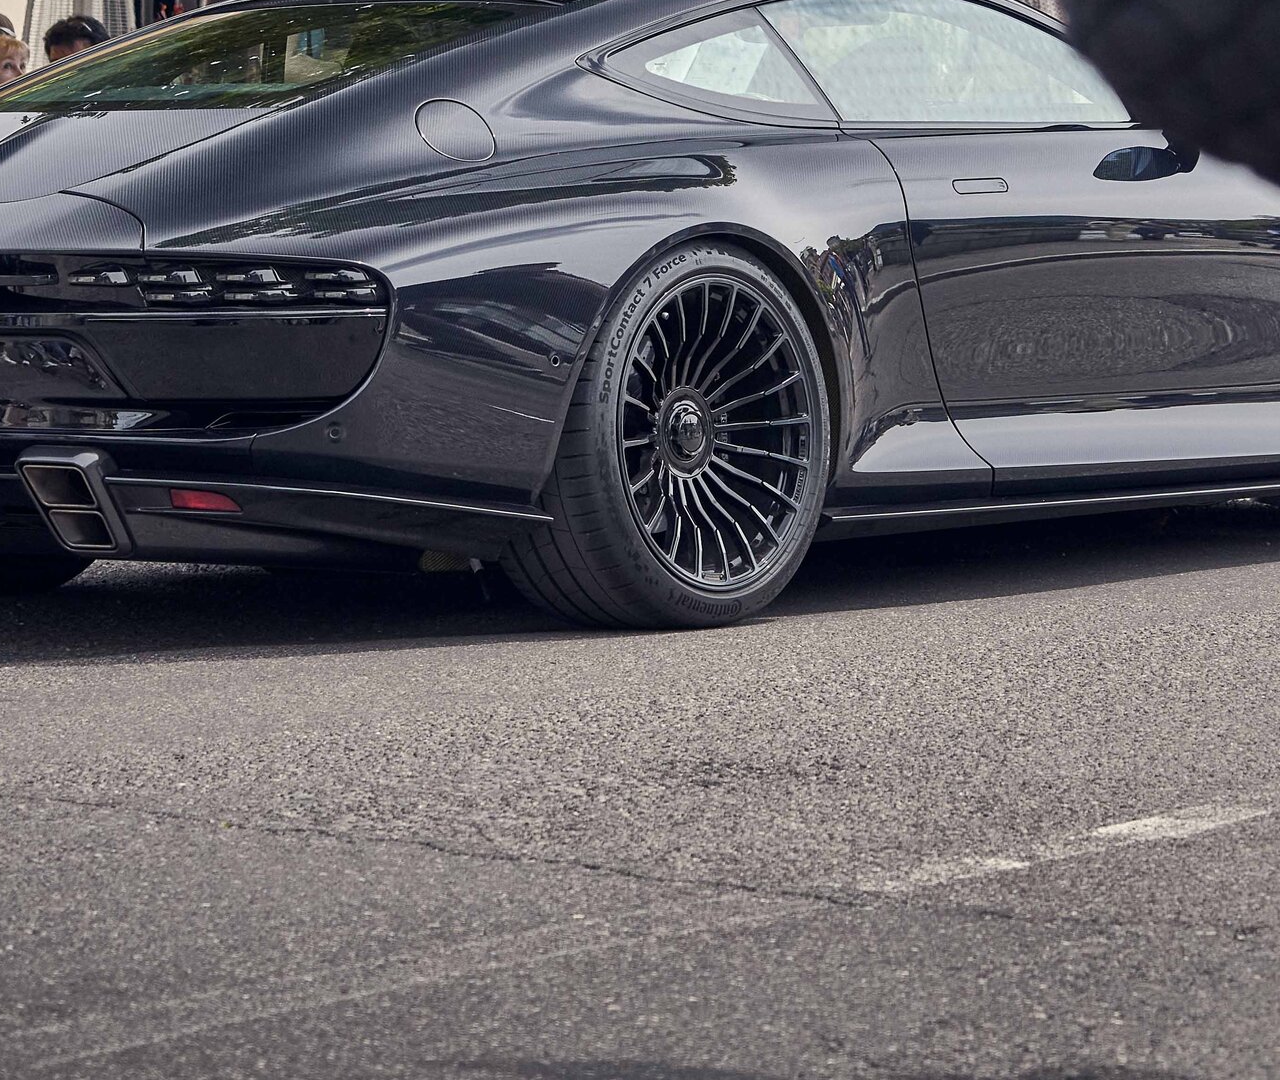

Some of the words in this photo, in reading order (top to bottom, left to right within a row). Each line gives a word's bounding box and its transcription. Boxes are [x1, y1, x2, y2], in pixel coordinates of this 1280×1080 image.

[600, 288, 646, 404] SportContact
[643, 277, 653, 288] 7
[651, 253, 687, 280] Force
[676, 592, 742, 618] Continental
